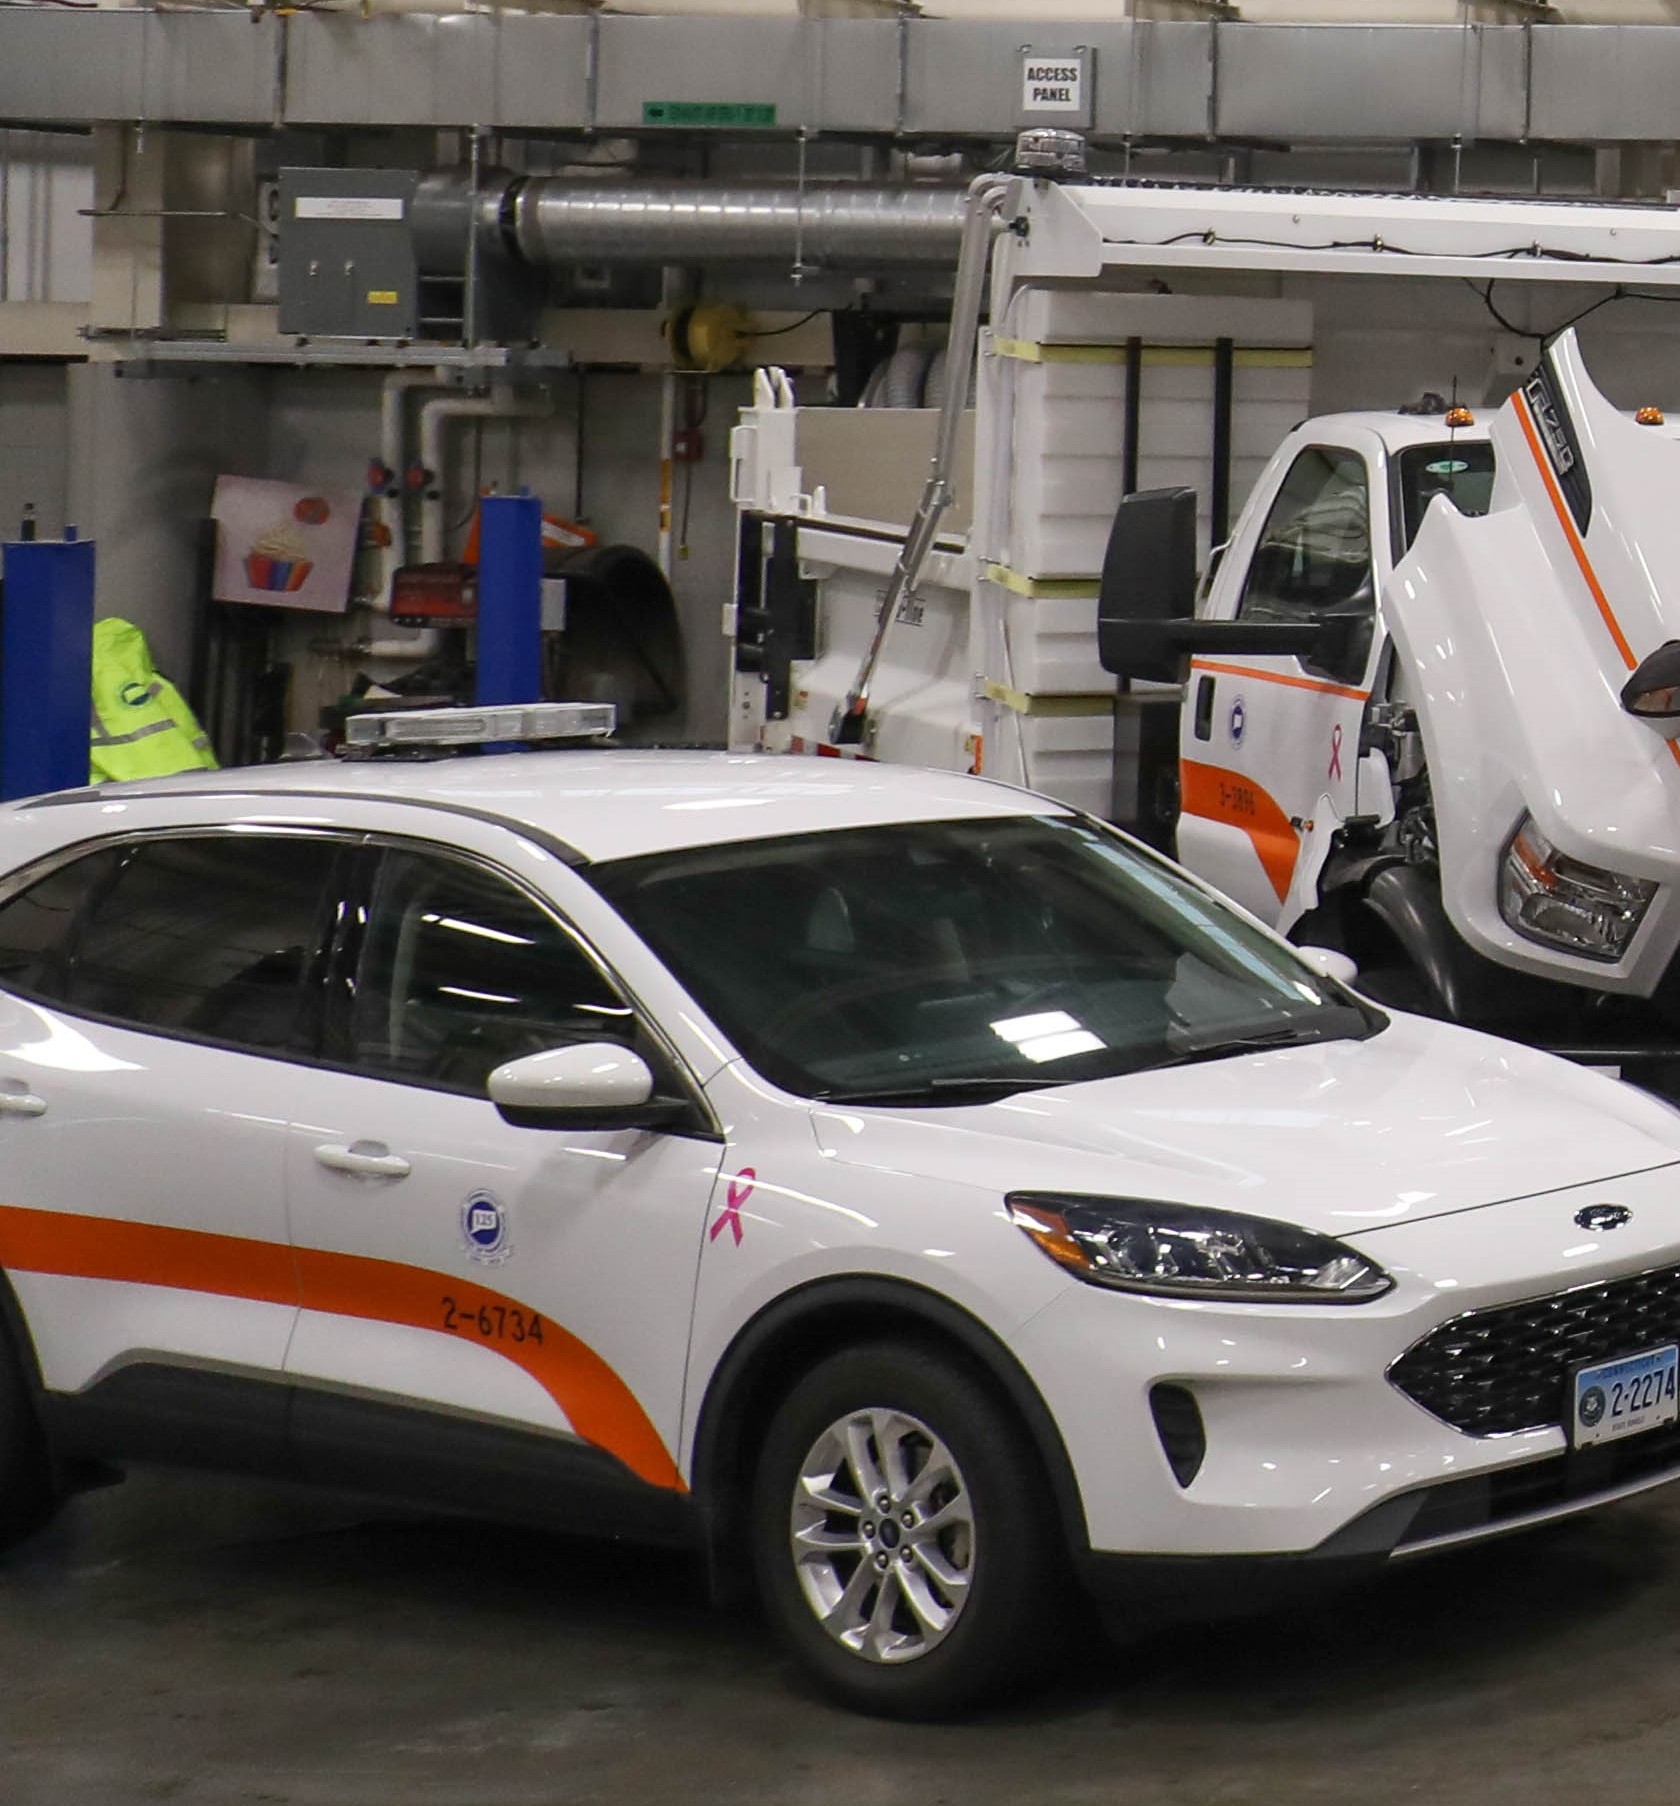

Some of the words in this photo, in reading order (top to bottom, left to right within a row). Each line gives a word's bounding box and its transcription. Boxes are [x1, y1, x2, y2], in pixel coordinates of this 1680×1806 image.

[1027, 67, 1077, 81] ACCESS
[1033, 87, 1071, 102] PANEL
[441, 1296, 543, 1347] 2-6734
